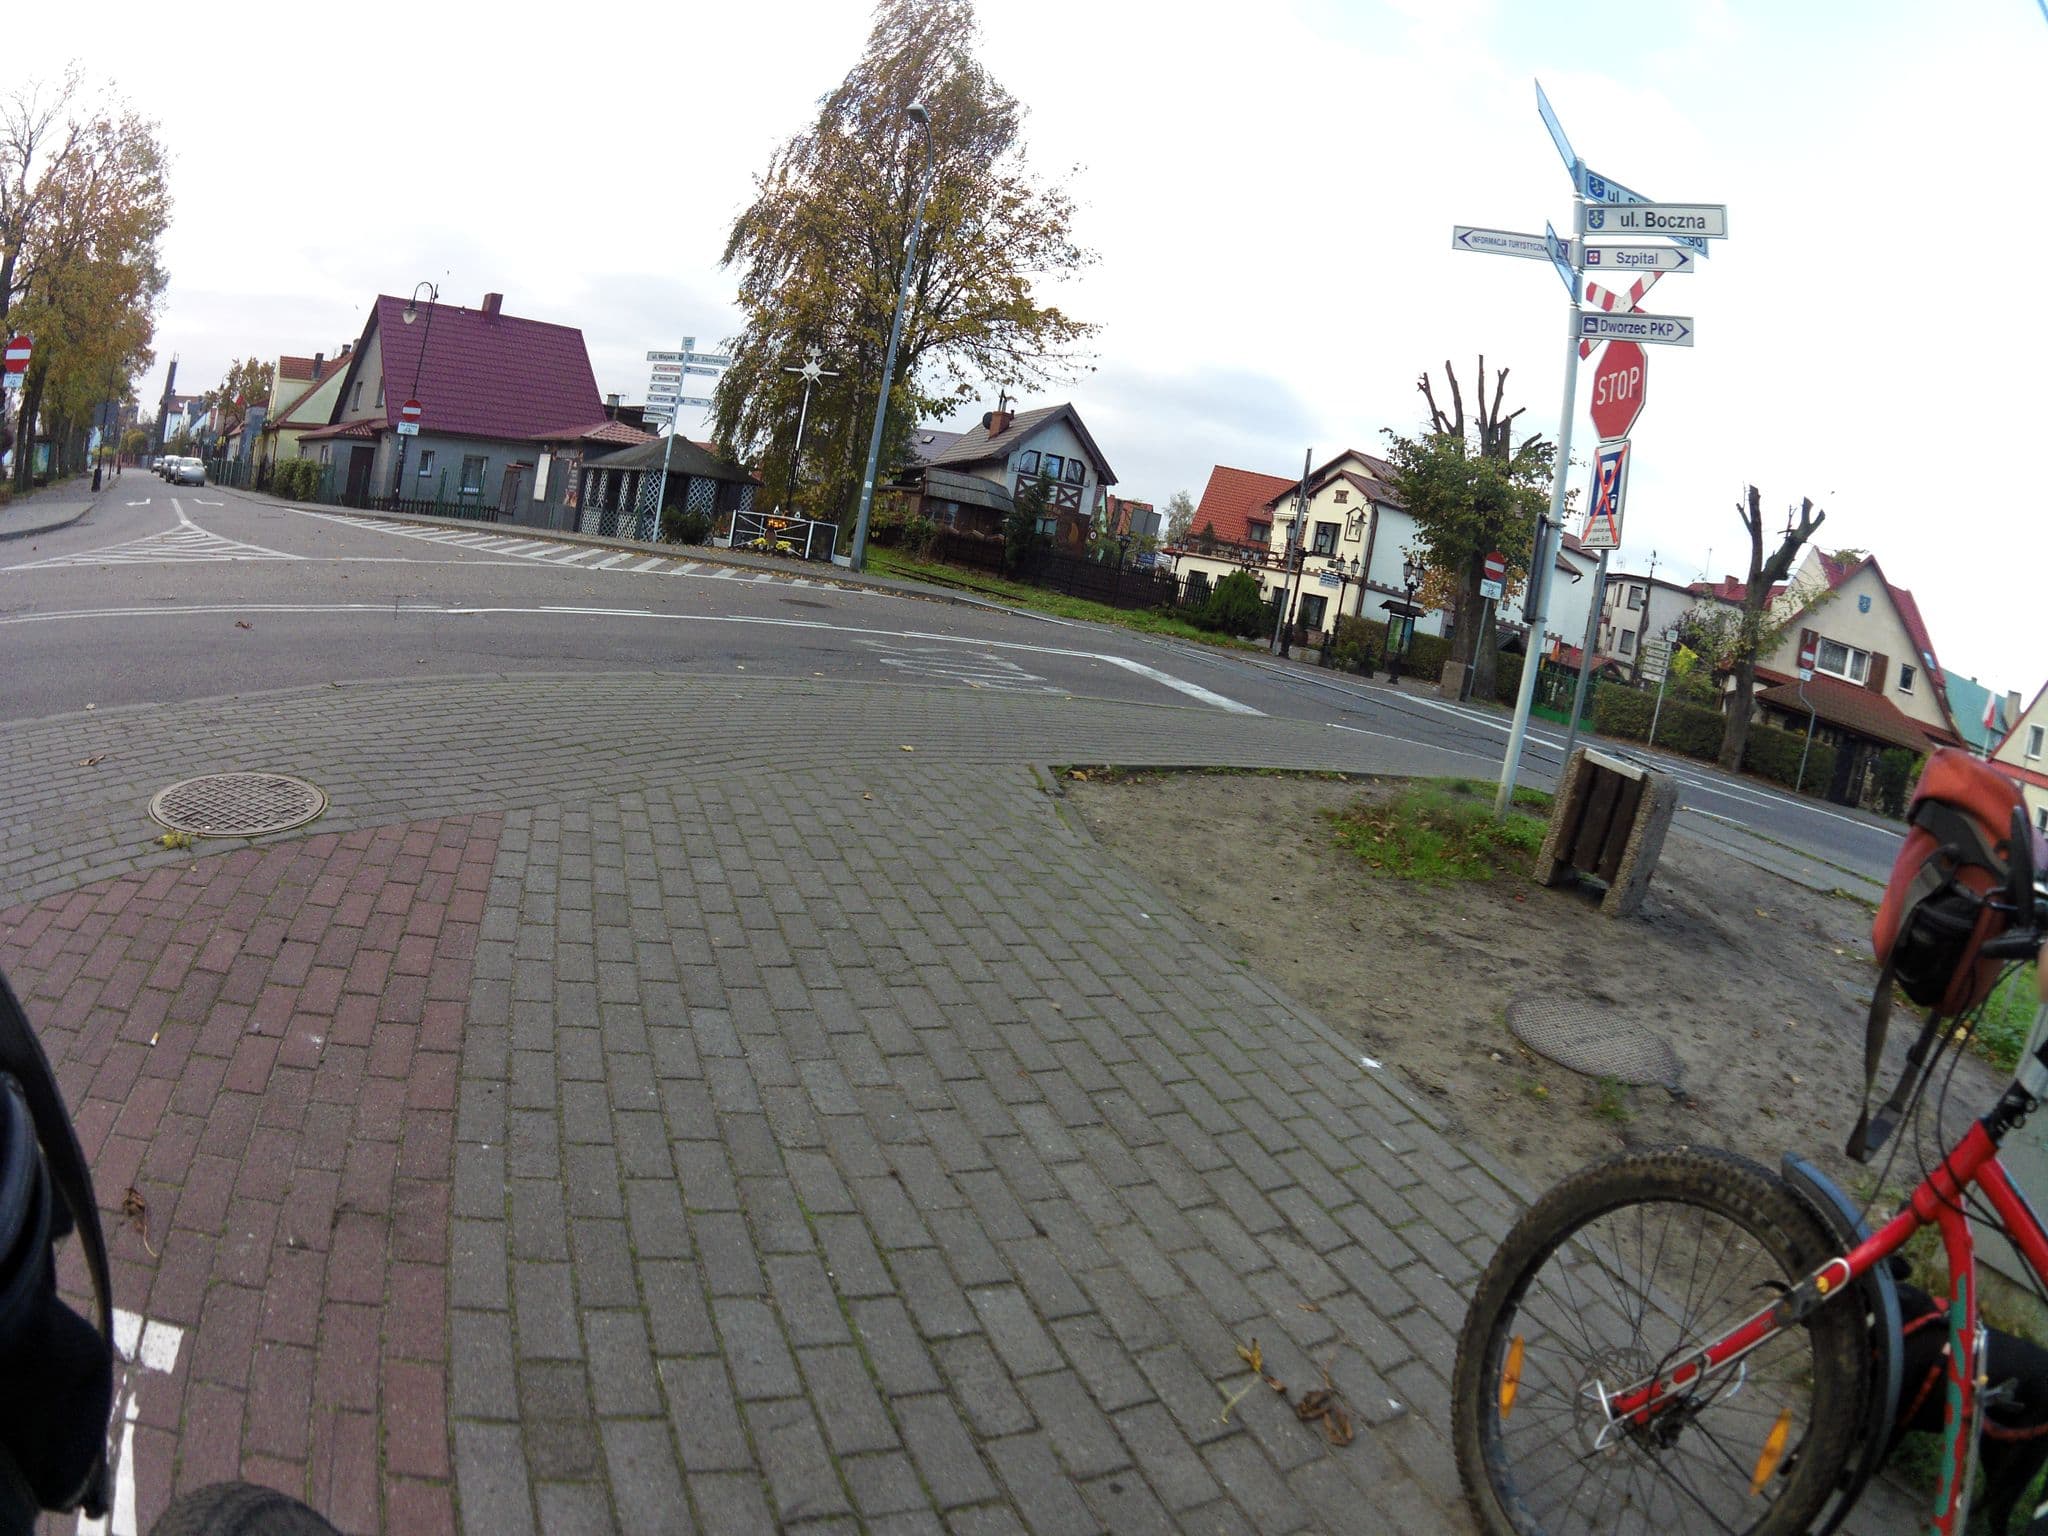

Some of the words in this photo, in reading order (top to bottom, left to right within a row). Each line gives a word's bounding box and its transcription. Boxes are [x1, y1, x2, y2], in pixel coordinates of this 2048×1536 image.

[1620, 212, 1639, 228] ul.
[1645, 211, 1706, 229] Boczna
[1616, 251, 1659, 267] Szpital
[1600, 319, 1648, 335] Dworzec
[1650, 322, 1675, 337] PKP
[1596, 366, 1640, 405] STOP
